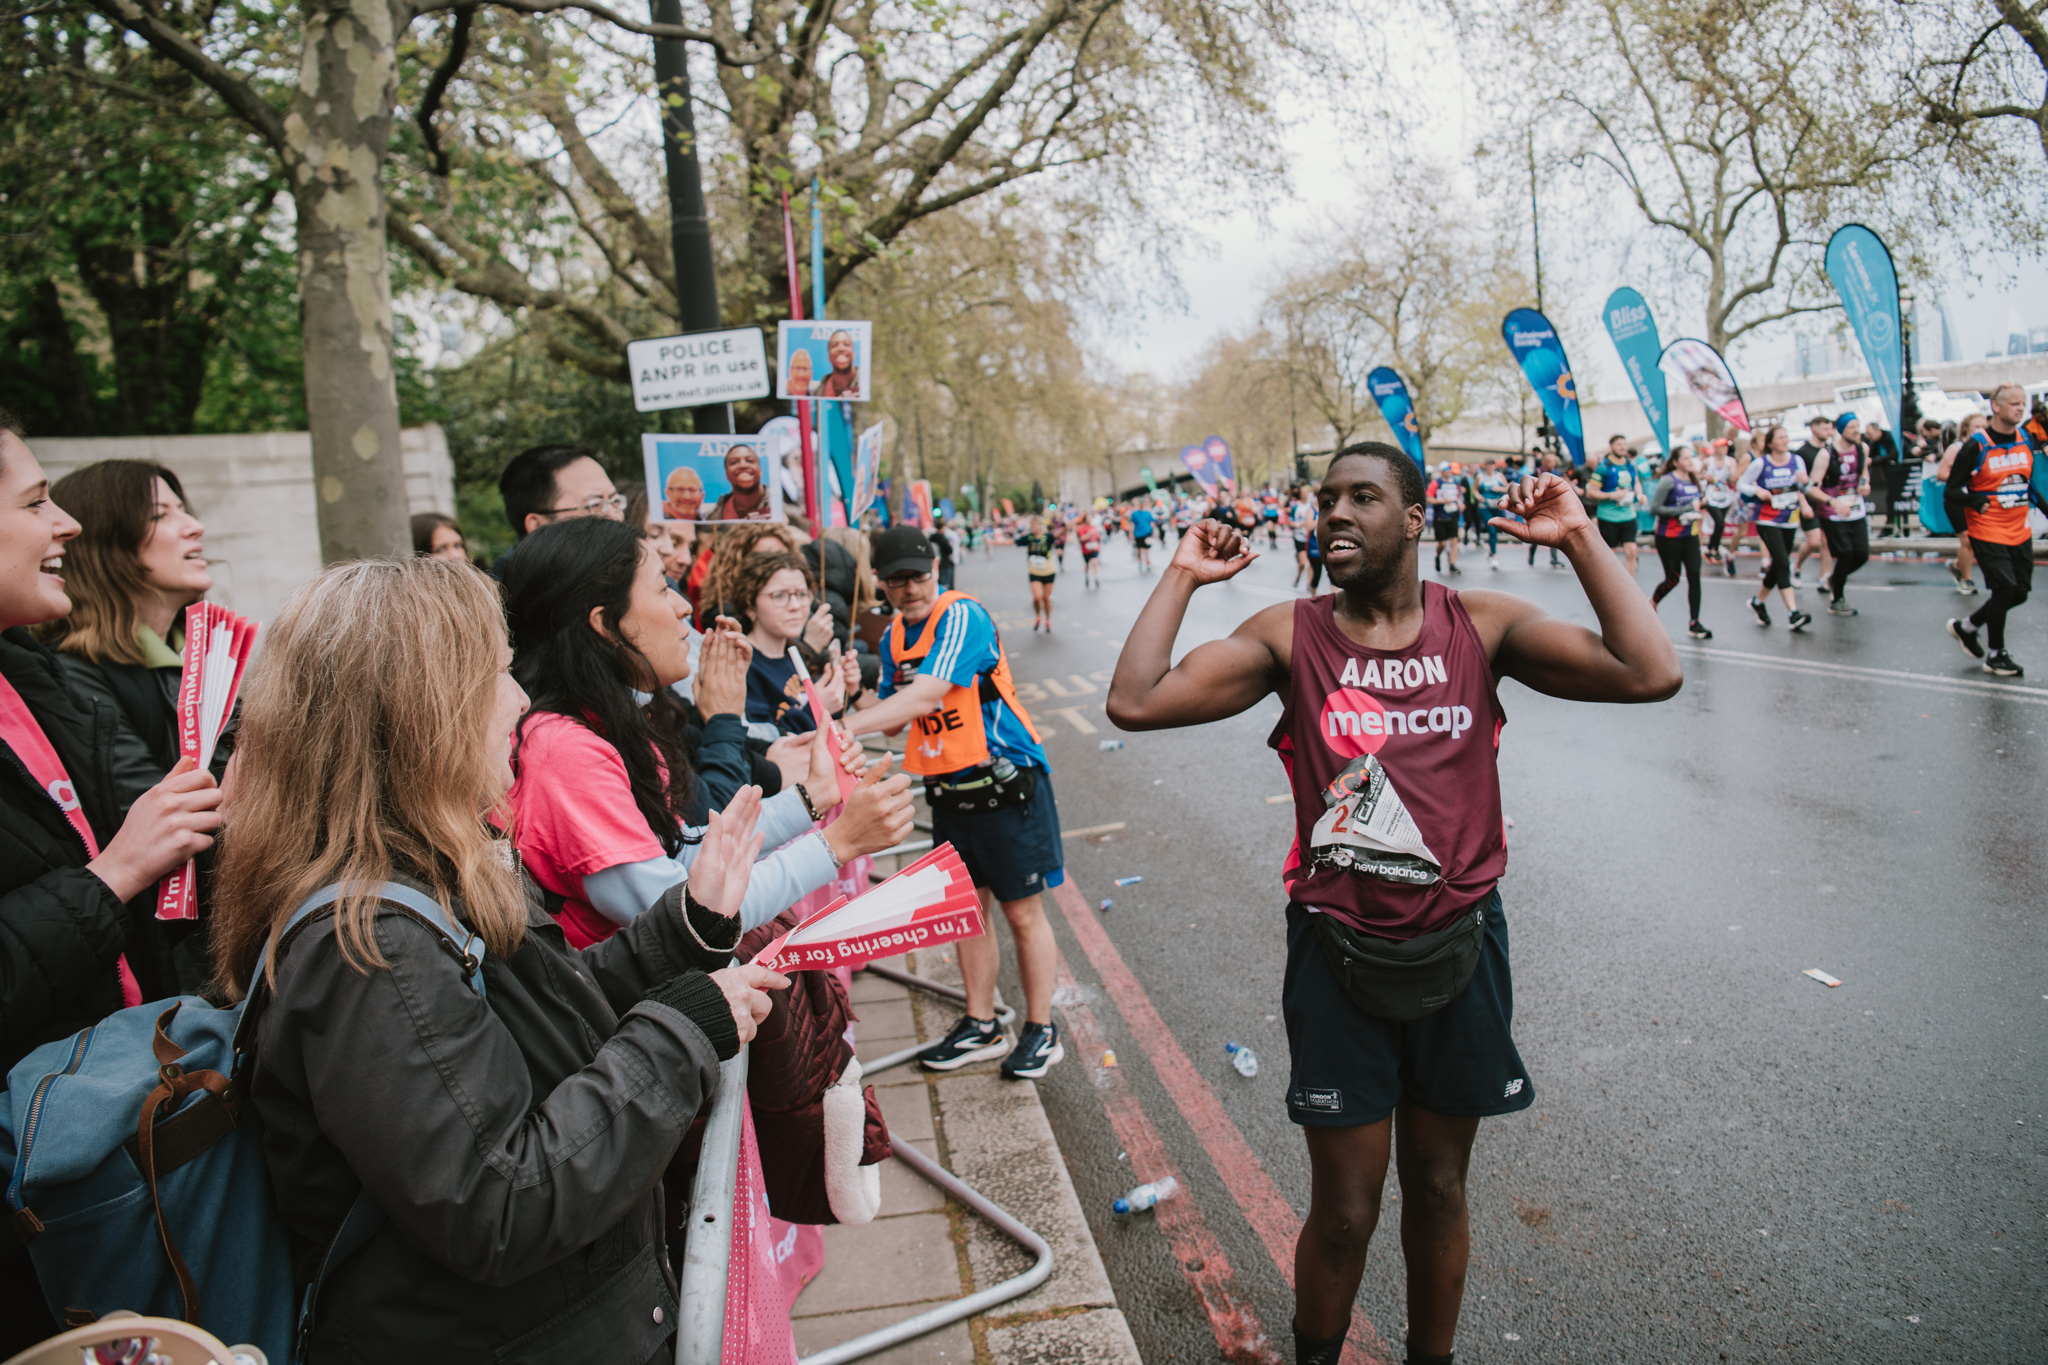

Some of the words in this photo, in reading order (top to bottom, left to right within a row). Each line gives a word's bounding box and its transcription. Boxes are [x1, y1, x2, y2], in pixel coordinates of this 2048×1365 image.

[1610, 304, 1647, 330] Bliss
[660, 339, 733, 361] POLICE
[641, 363, 697, 384] ANPR
[703, 360, 720, 376] in
[727, 360, 759, 373] use
[641, 379, 764, 404] www.met.police.uk
[1339, 655, 1448, 690] AARON
[1327, 704, 1473, 740] mencap
[163, 876, 181, 910] I'm
[184, 612, 203, 751] #TeamMencap!
[1354, 861, 1377, 874] new
[1379, 864, 1428, 880] balance
[932, 916, 972, 935] I'm
[837, 927, 929, 957] cheering
[806, 948, 835, 964] for
